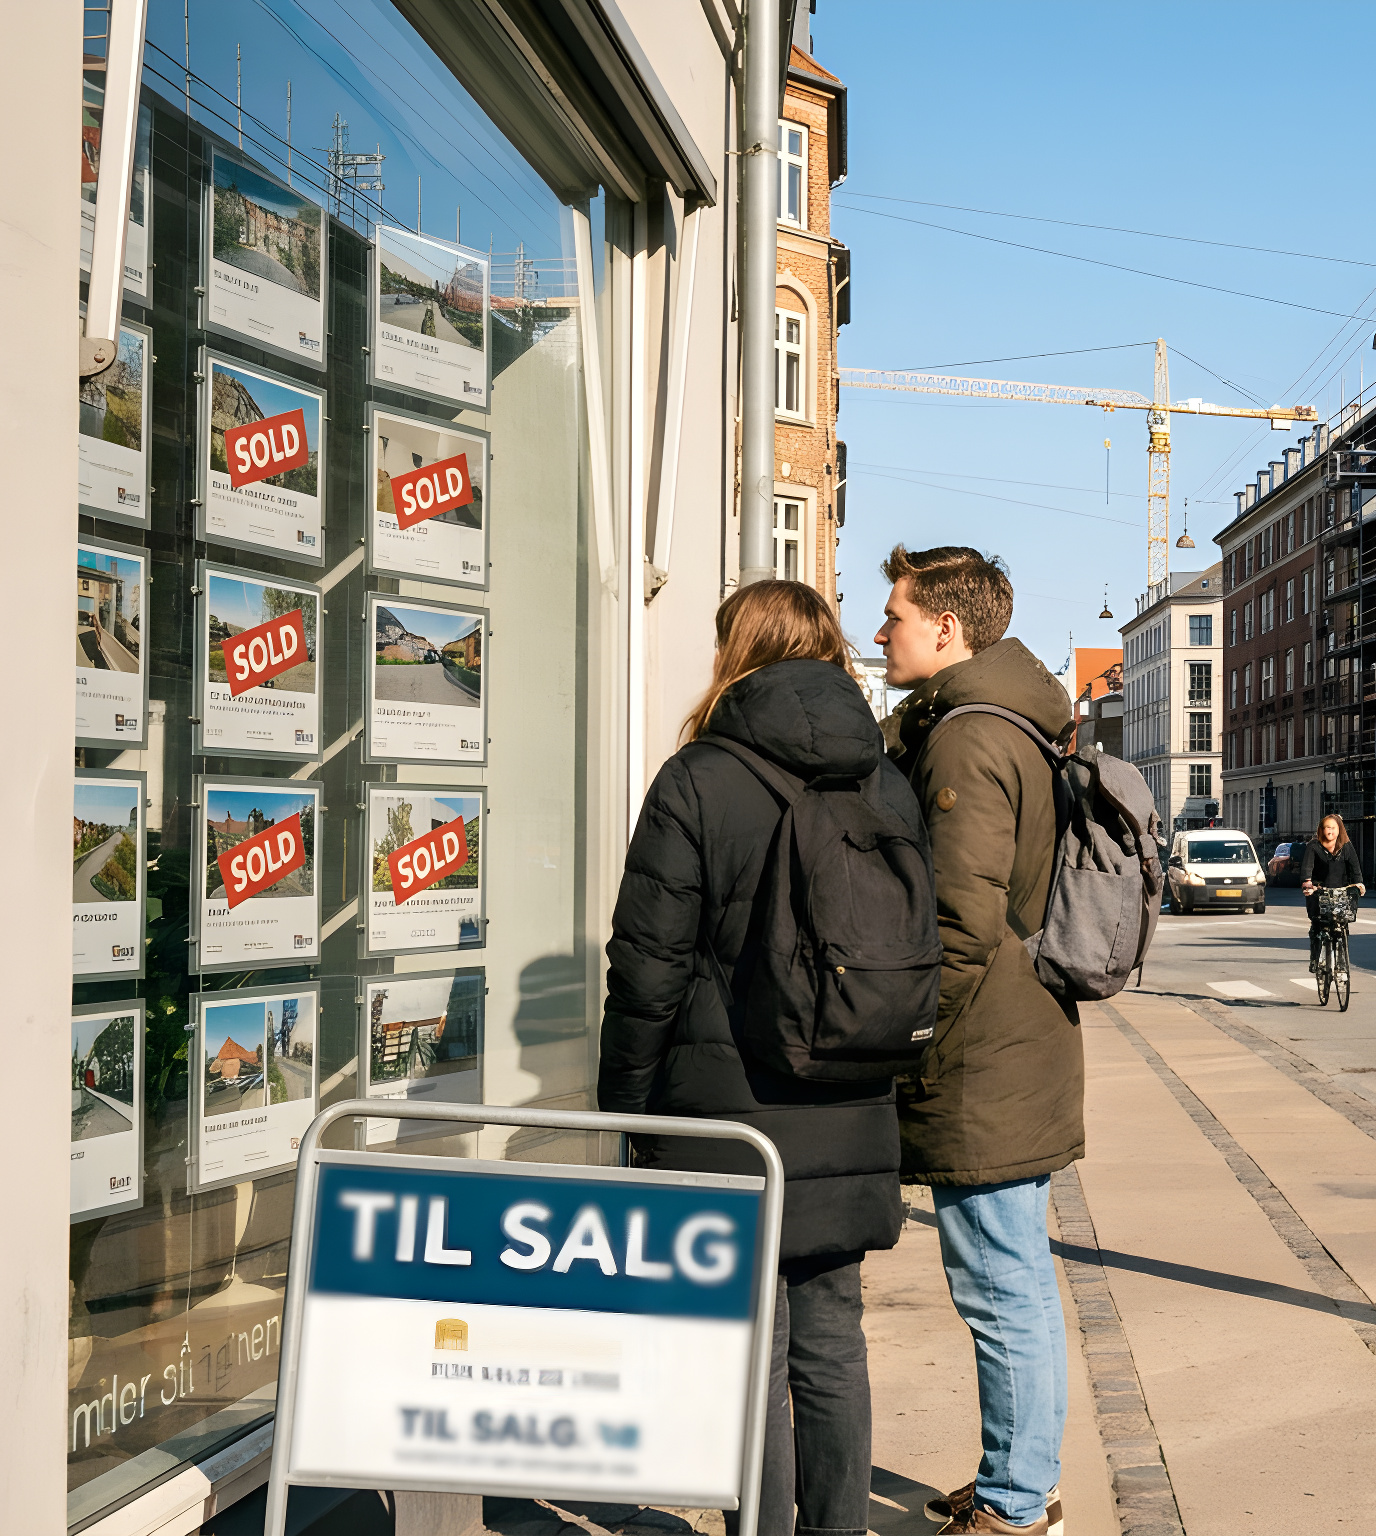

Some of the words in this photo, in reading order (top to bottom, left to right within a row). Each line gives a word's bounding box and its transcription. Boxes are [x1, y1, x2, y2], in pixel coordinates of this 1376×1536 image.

[234, 423, 300, 474] SOLD
[401, 467, 463, 516] SOLD
[232, 624, 298, 681] SOLD
[230, 830, 296, 893] SOLD
[397, 831, 460, 889] SOLD
[339, 1190, 472, 1266] TIL
[500, 1202, 738, 1284] SALG
[400, 1407, 455, 1442] TIL
